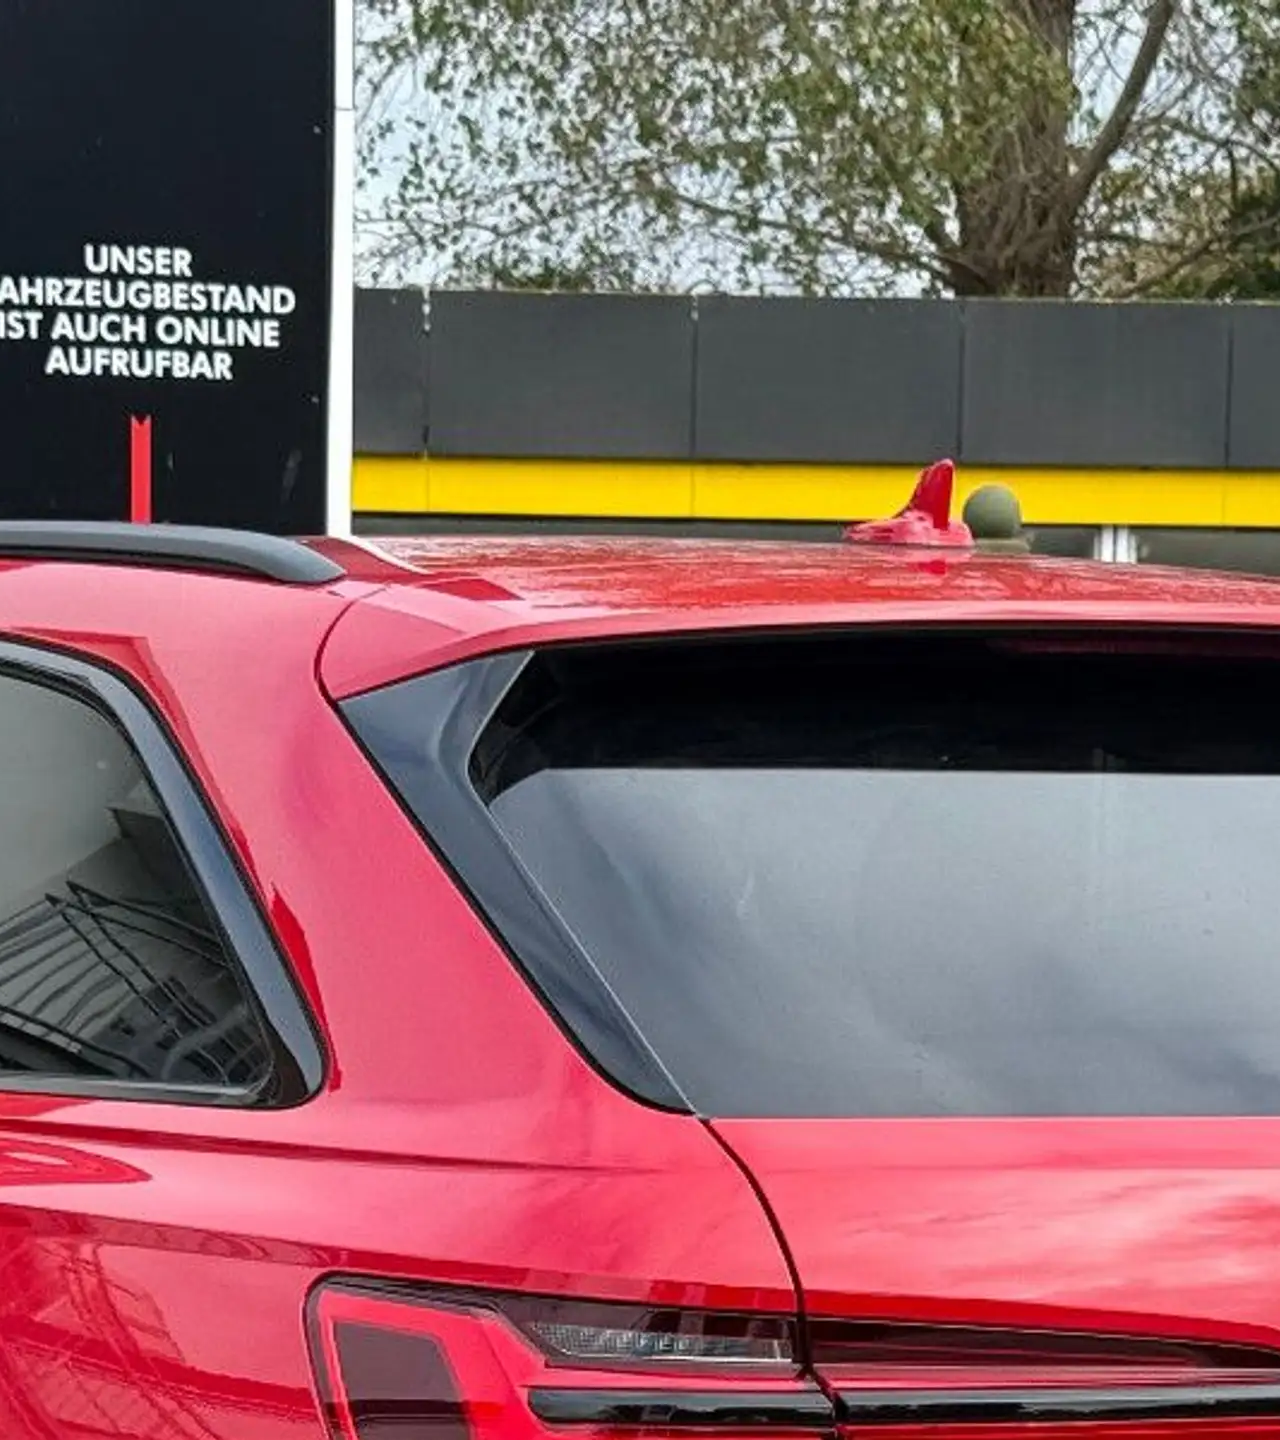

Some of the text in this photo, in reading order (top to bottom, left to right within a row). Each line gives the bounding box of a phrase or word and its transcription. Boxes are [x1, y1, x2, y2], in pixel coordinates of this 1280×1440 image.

[84, 244, 192, 277] UNSER
[51, 314, 147, 344] AUCH
[156, 317, 280, 348] ONLINE
[45, 346, 233, 381] AUFRUFBAR
